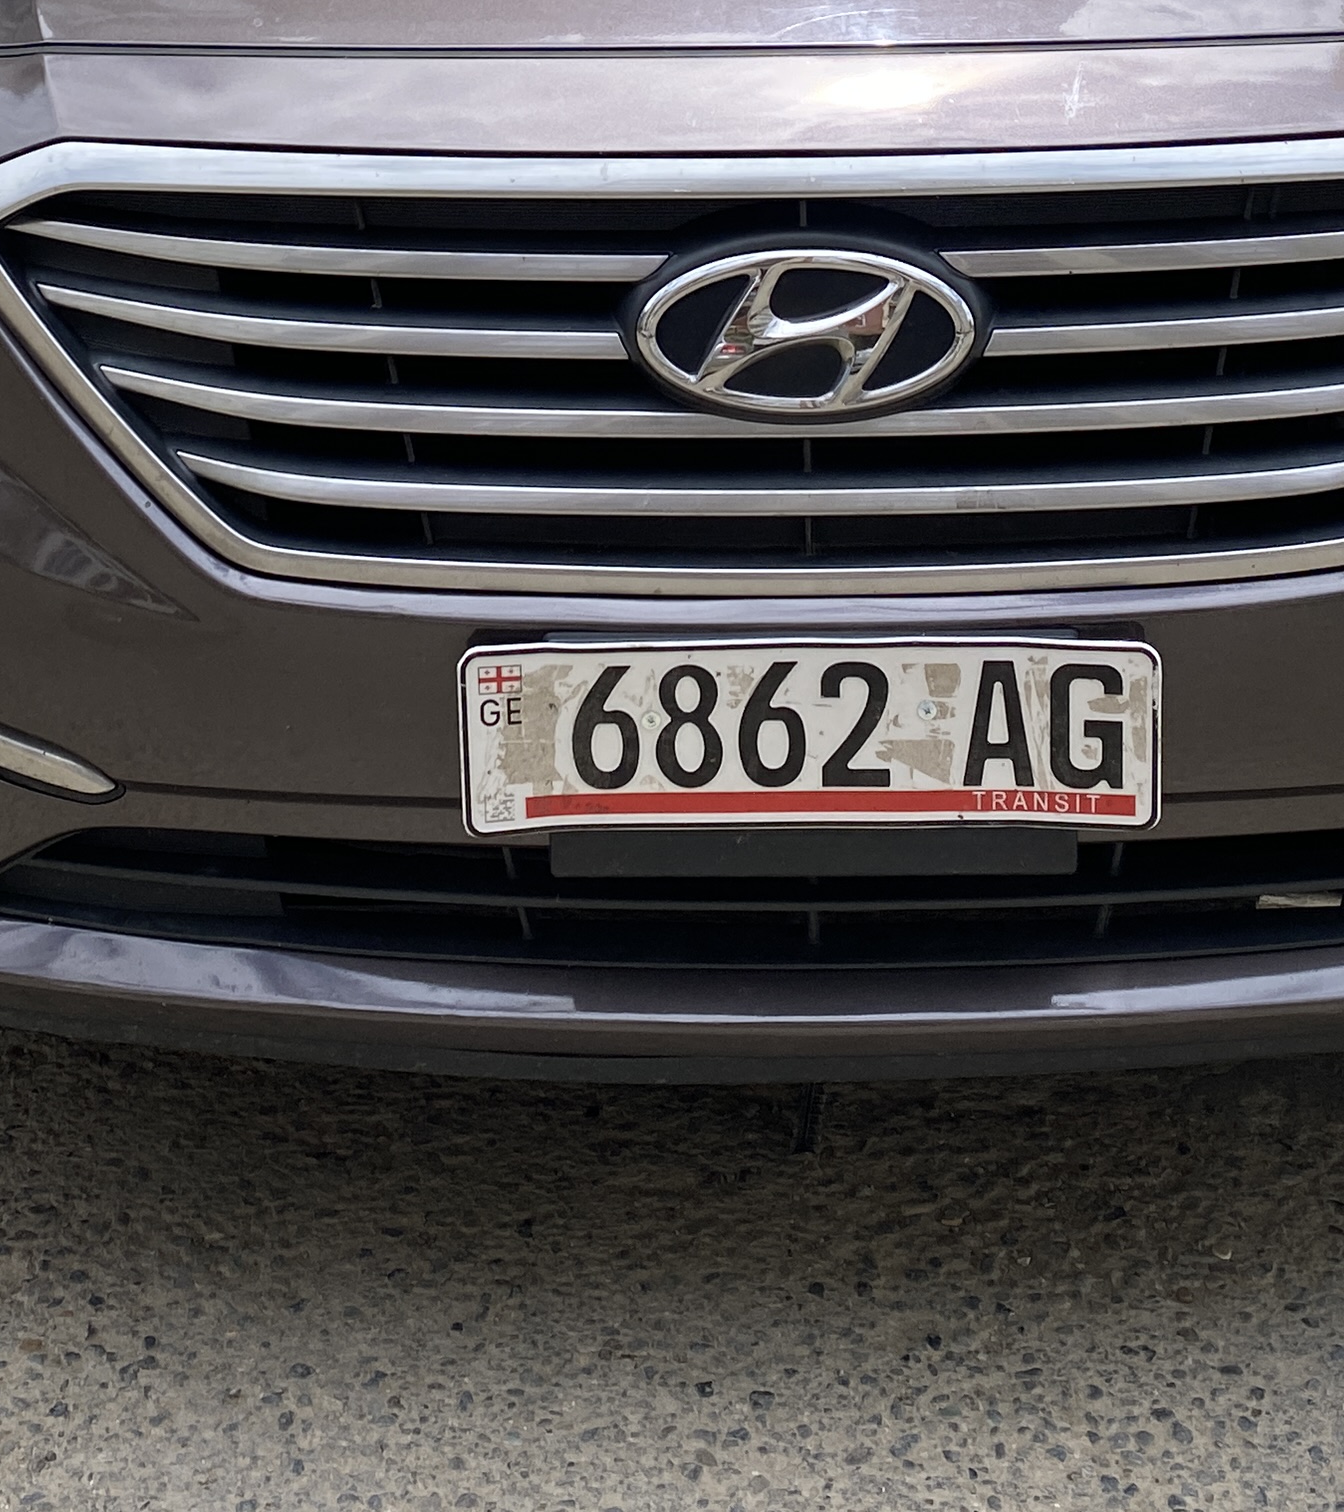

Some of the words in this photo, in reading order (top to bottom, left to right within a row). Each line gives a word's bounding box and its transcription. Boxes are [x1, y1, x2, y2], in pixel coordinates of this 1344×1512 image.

[479, 698, 523, 727] GE
[571, 660, 892, 790] 6862
[962, 659, 1125, 789] AG
[972, 790, 1101, 814] TRANSIT
